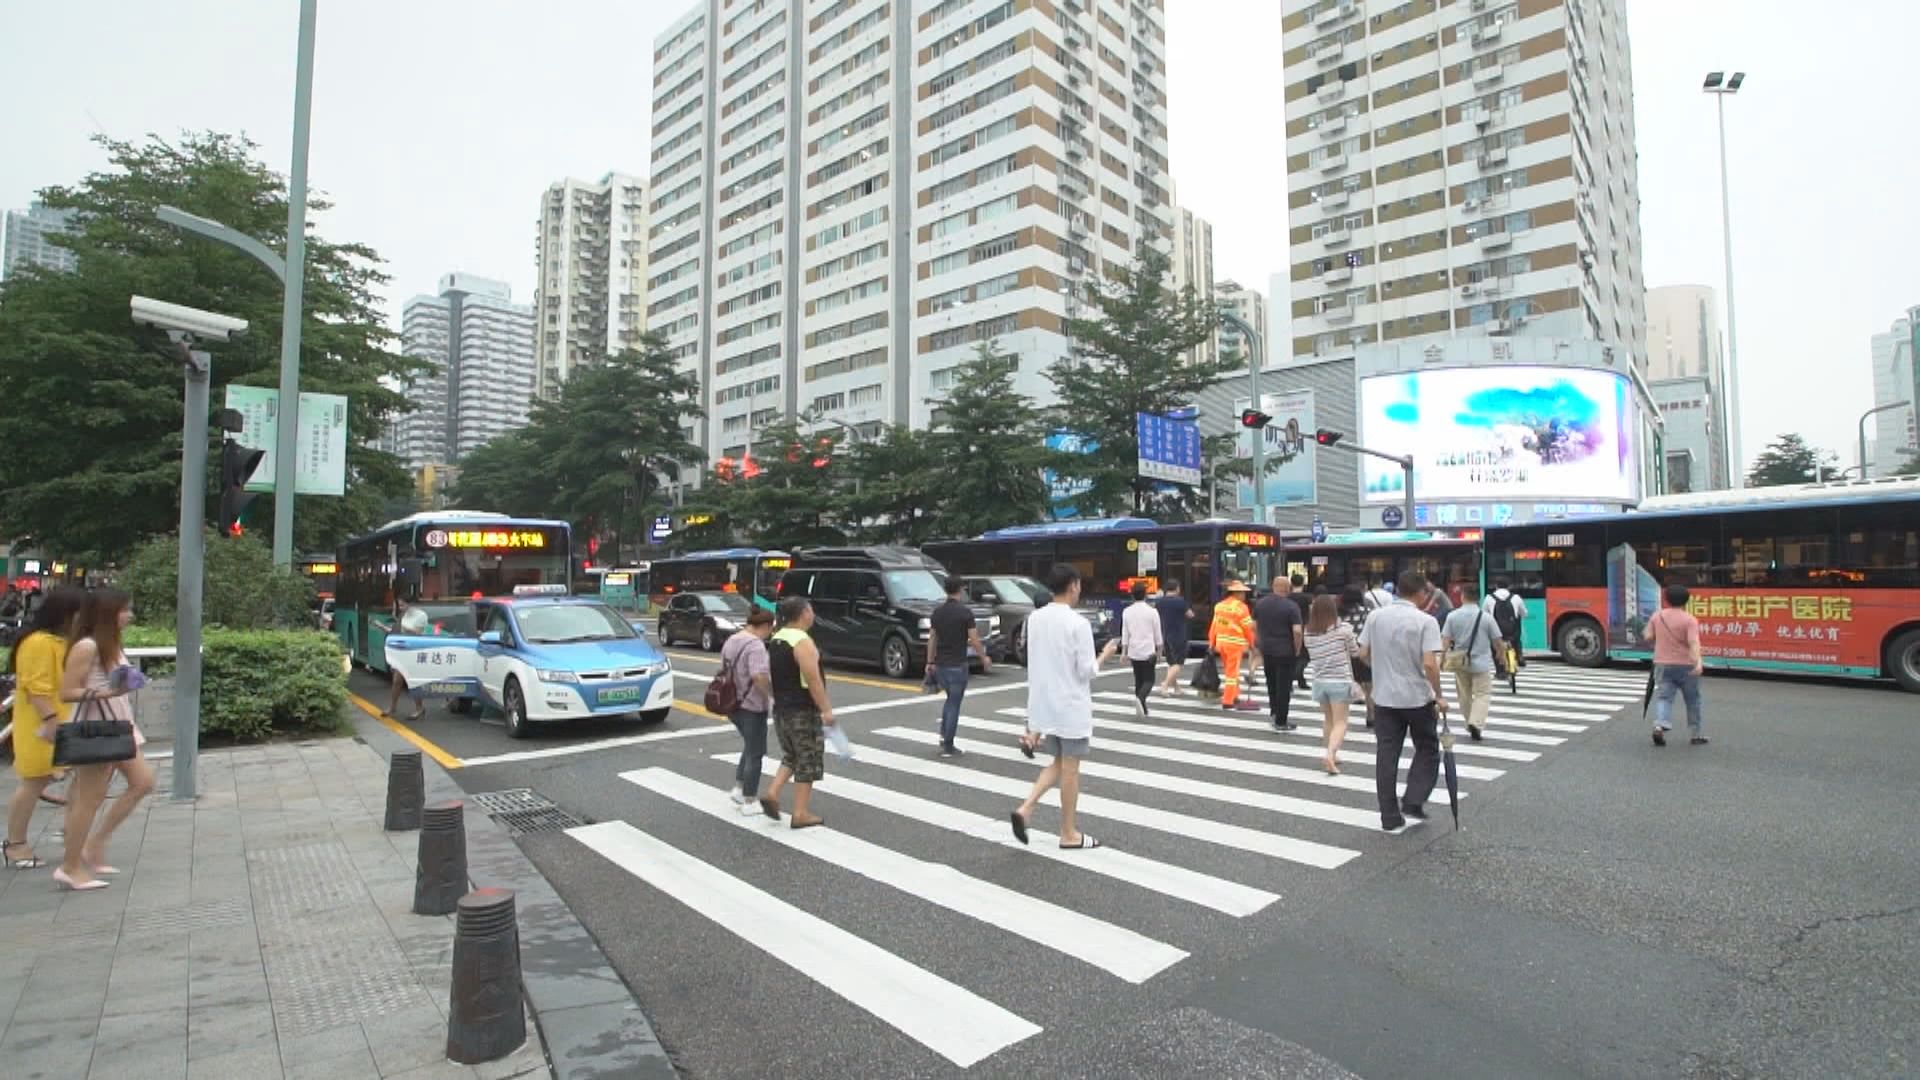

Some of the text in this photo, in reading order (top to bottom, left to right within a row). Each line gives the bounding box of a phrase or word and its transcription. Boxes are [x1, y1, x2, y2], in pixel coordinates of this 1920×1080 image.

[1685, 594, 1853, 621] 怡康妇产医院
[1776, 625, 1840, 641] 优生优育
[416, 651, 457, 665] 康达尔
